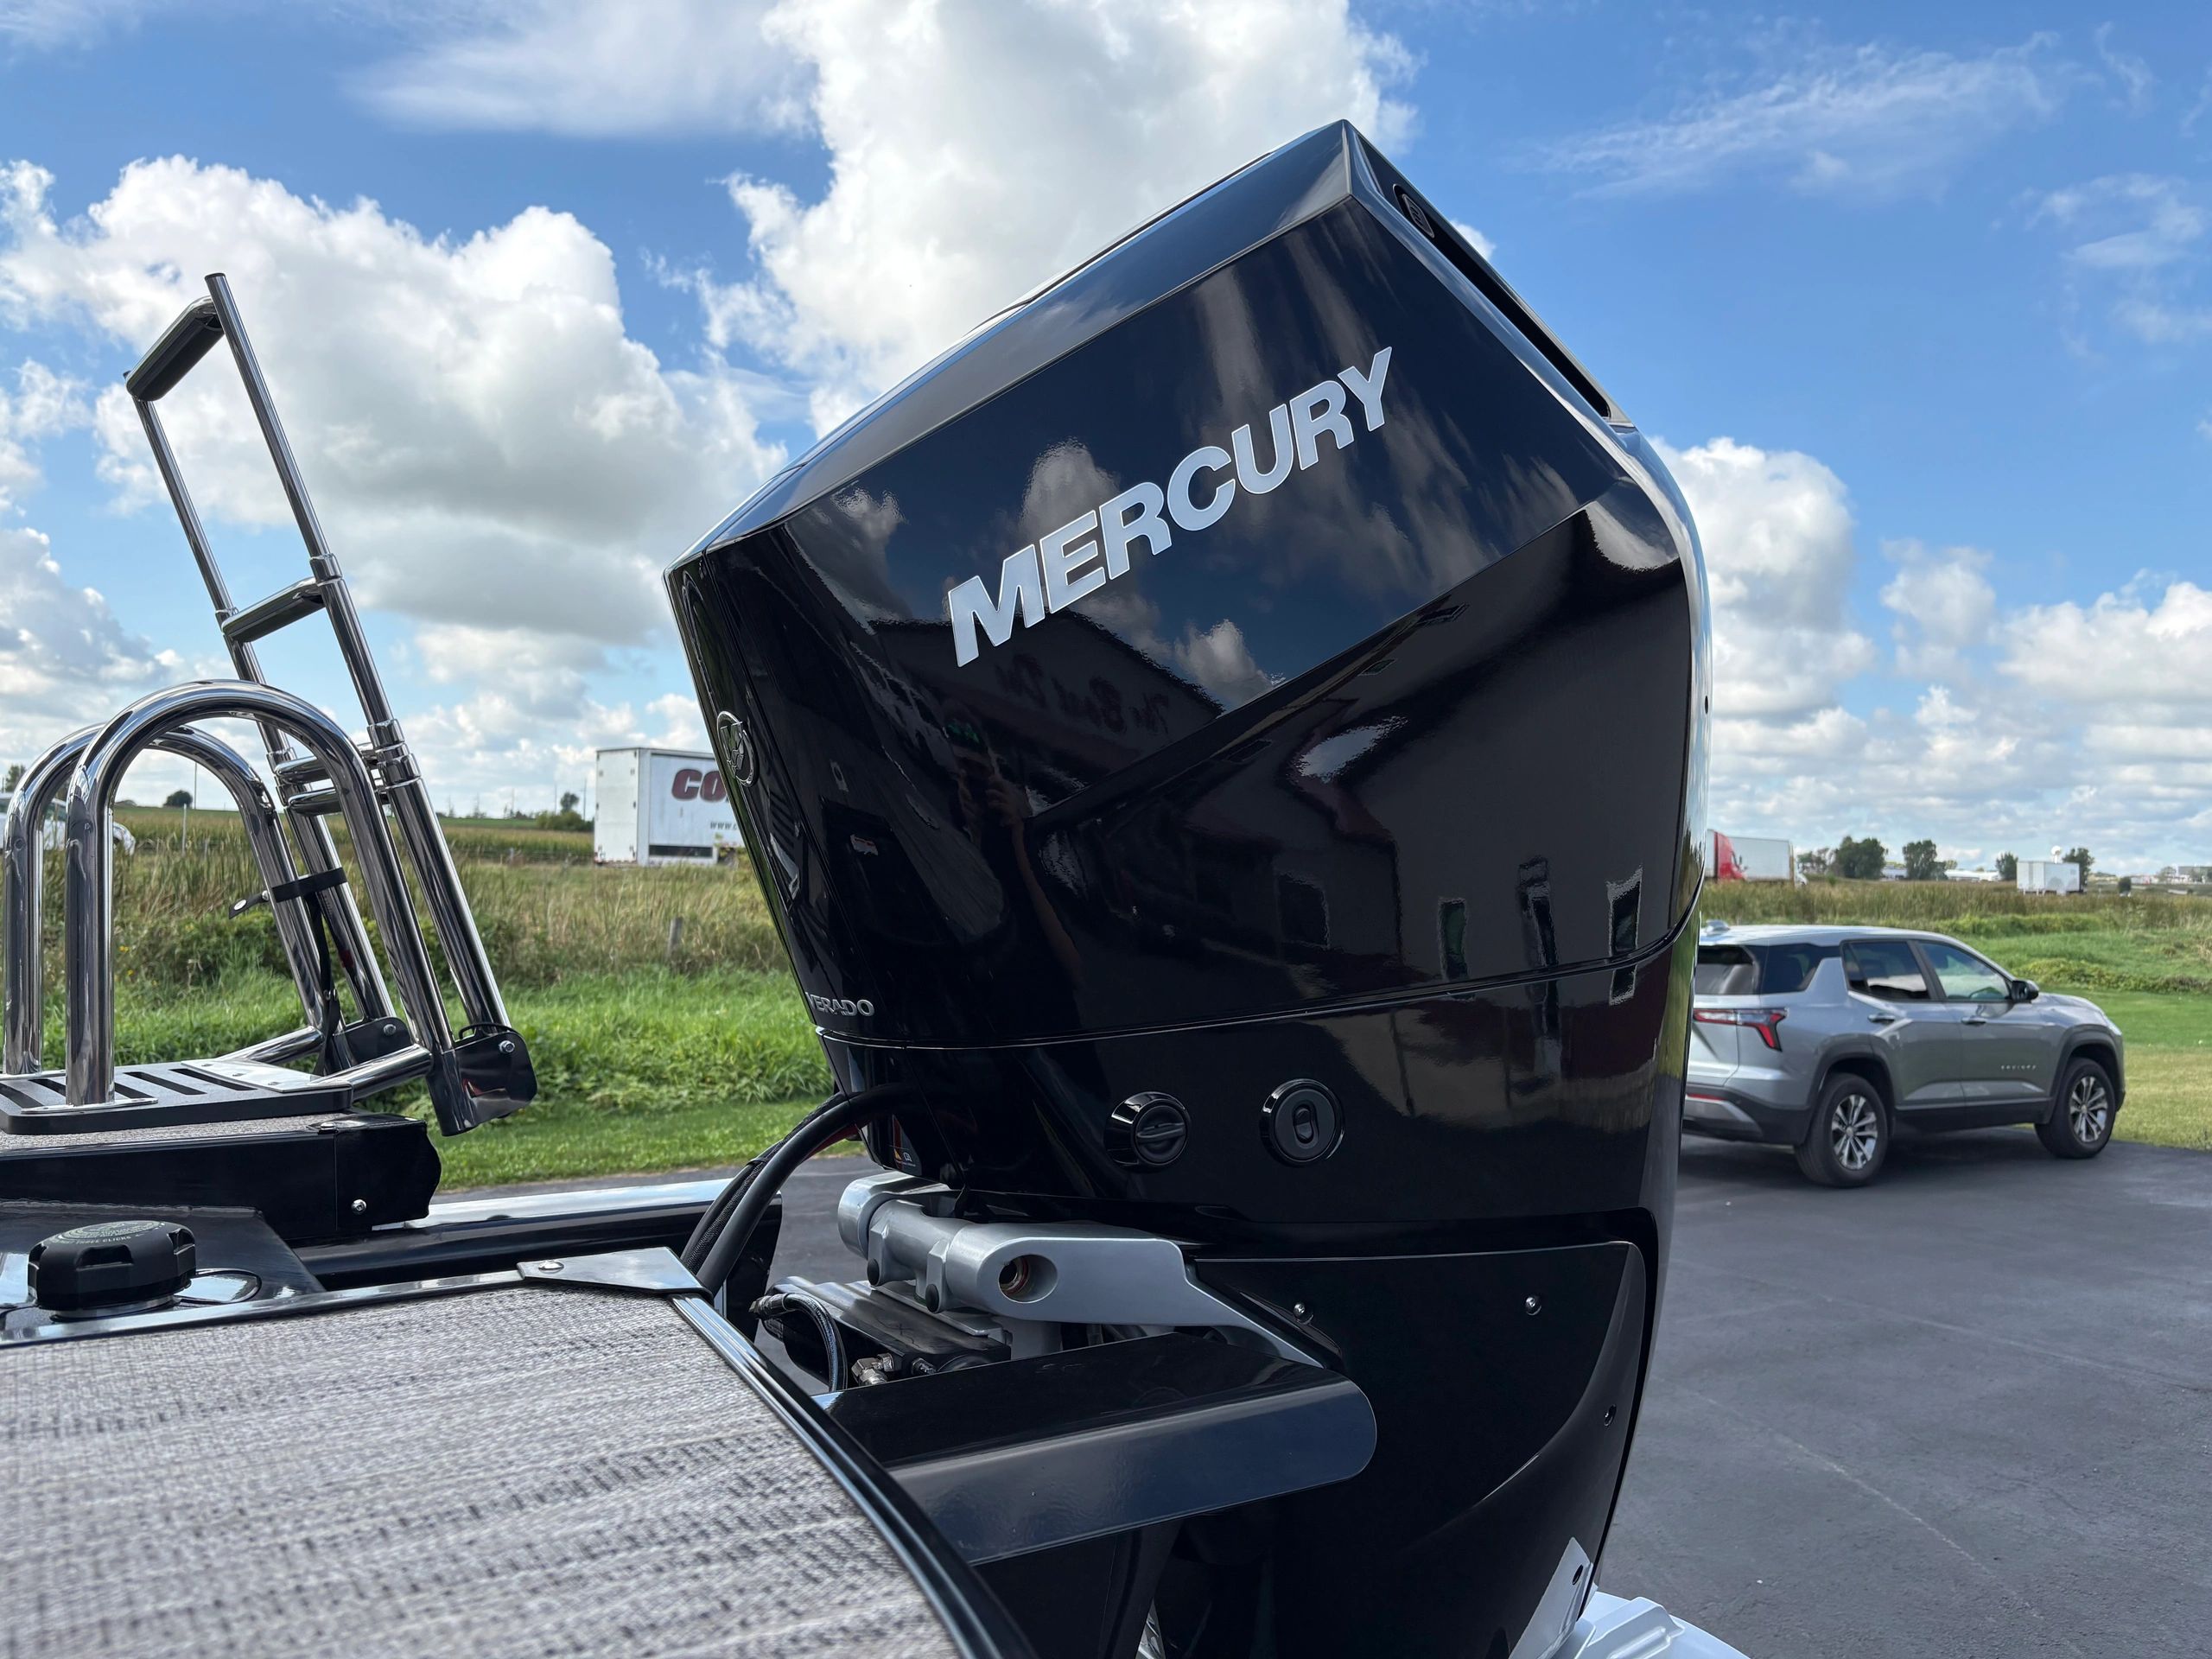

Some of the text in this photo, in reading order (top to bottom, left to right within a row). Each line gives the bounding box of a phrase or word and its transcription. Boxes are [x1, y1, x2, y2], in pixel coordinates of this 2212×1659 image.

[947, 346, 1394, 668] MERCURY
[671, 769, 731, 802] CO
[804, 991, 875, 1017] VERADO
